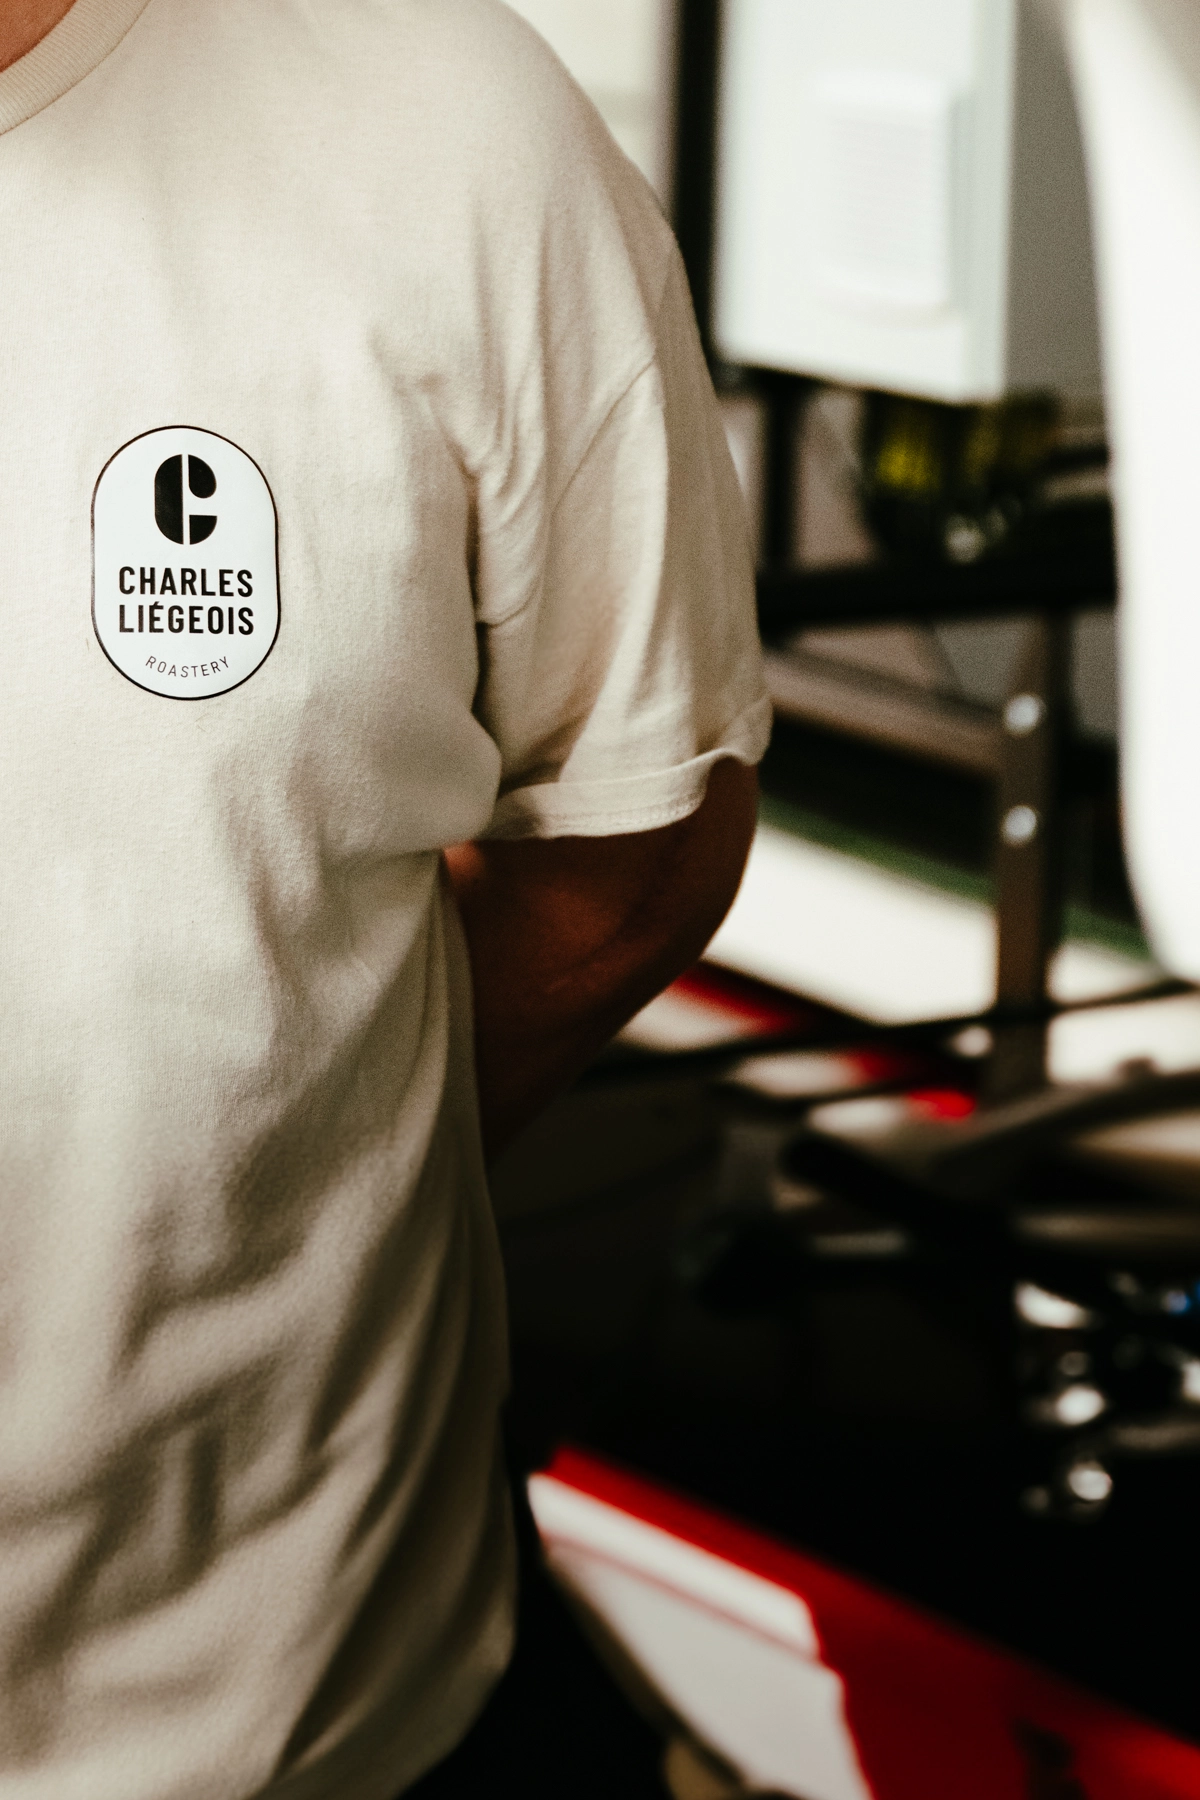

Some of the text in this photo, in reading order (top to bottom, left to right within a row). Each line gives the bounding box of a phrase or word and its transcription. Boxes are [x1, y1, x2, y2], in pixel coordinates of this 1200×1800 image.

[118, 566, 254, 598] CHARLES
[118, 601, 255, 636] LIÉGEOIS
[145, 655, 230, 678] ROASTERY
